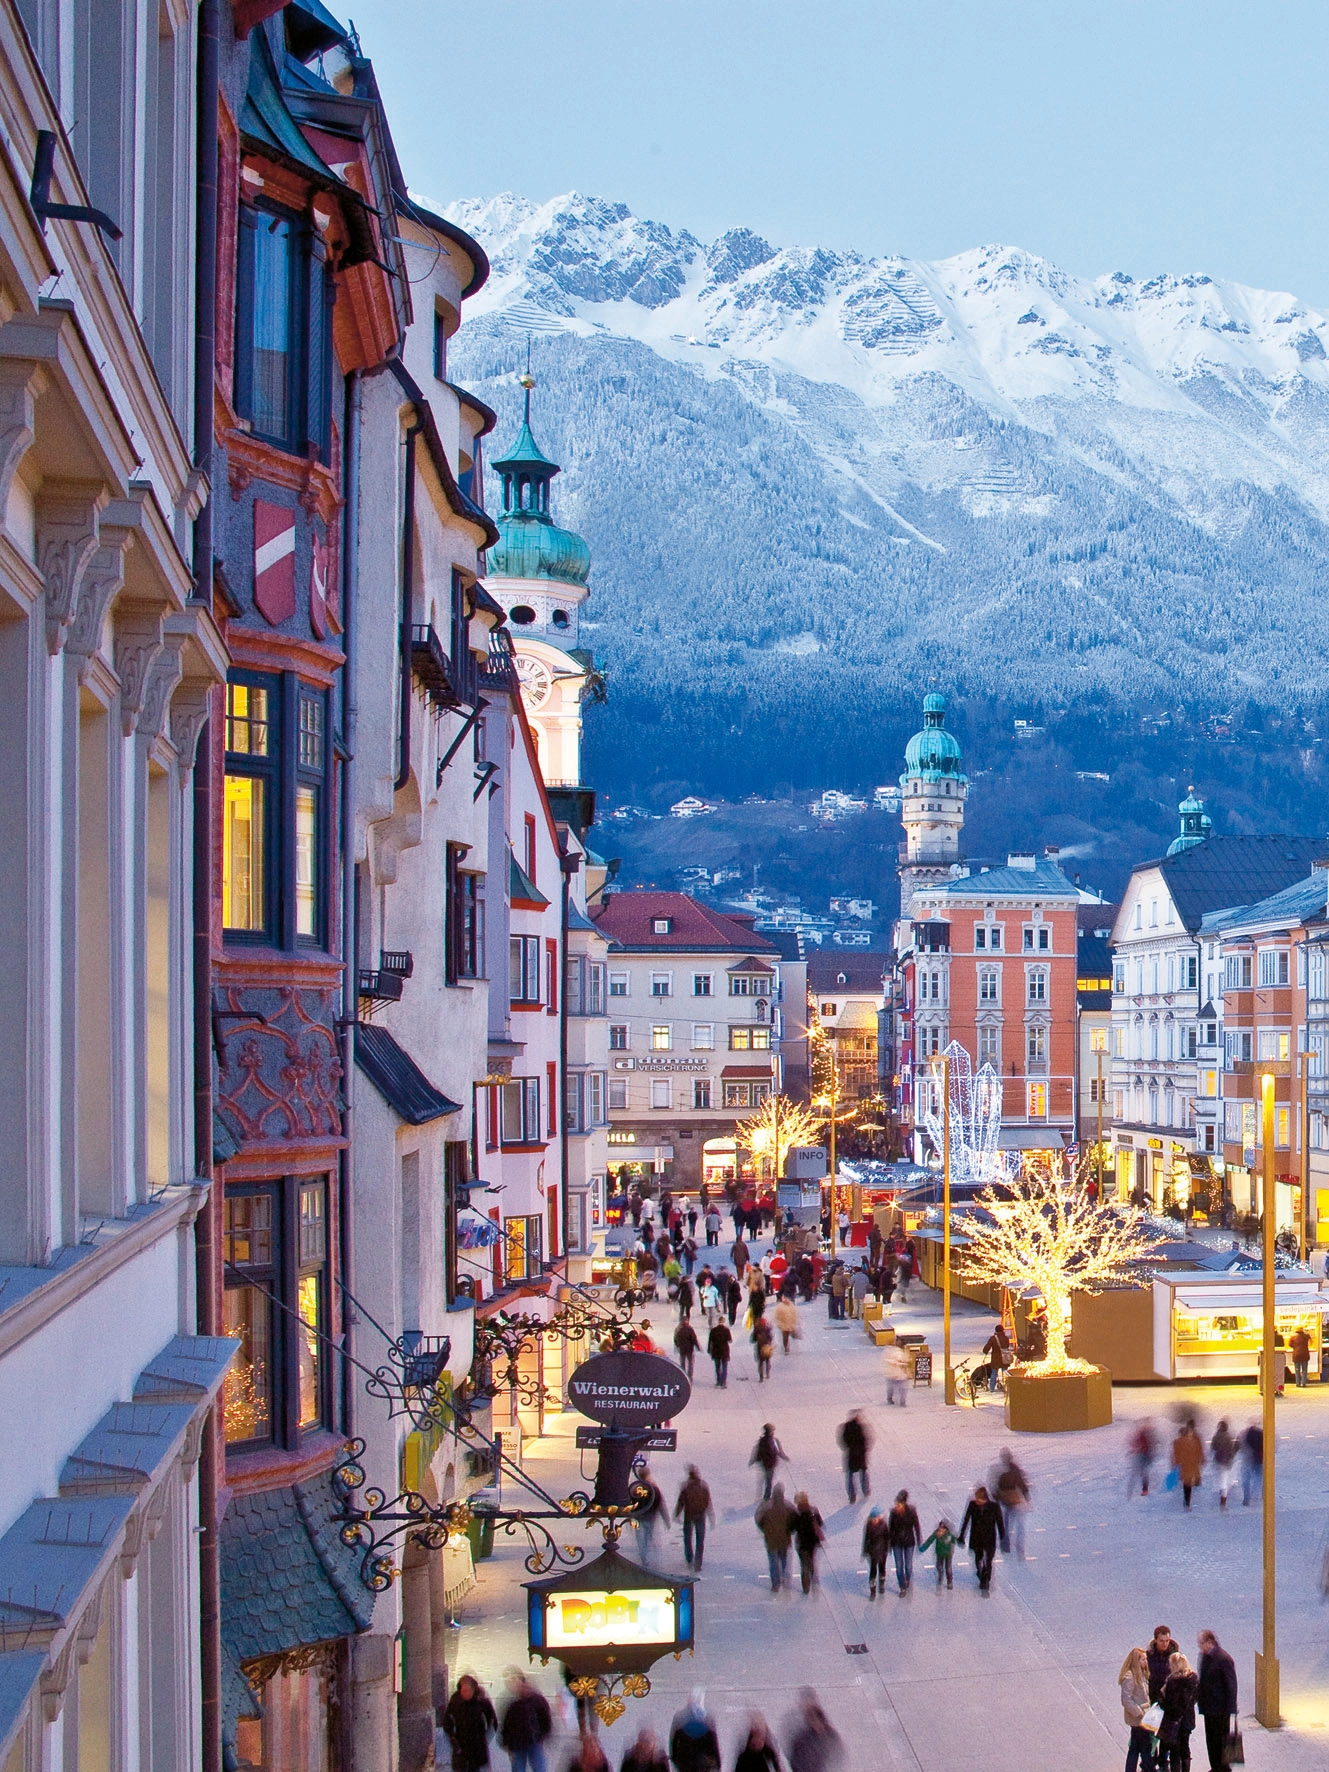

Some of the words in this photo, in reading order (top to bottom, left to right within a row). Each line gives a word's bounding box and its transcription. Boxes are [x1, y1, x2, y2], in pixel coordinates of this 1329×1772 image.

[638, 1064, 709, 1072] VERSICHERUNG
[799, 1151, 824, 1160] INFO
[594, 1400, 660, 1409] RESTAURANT
